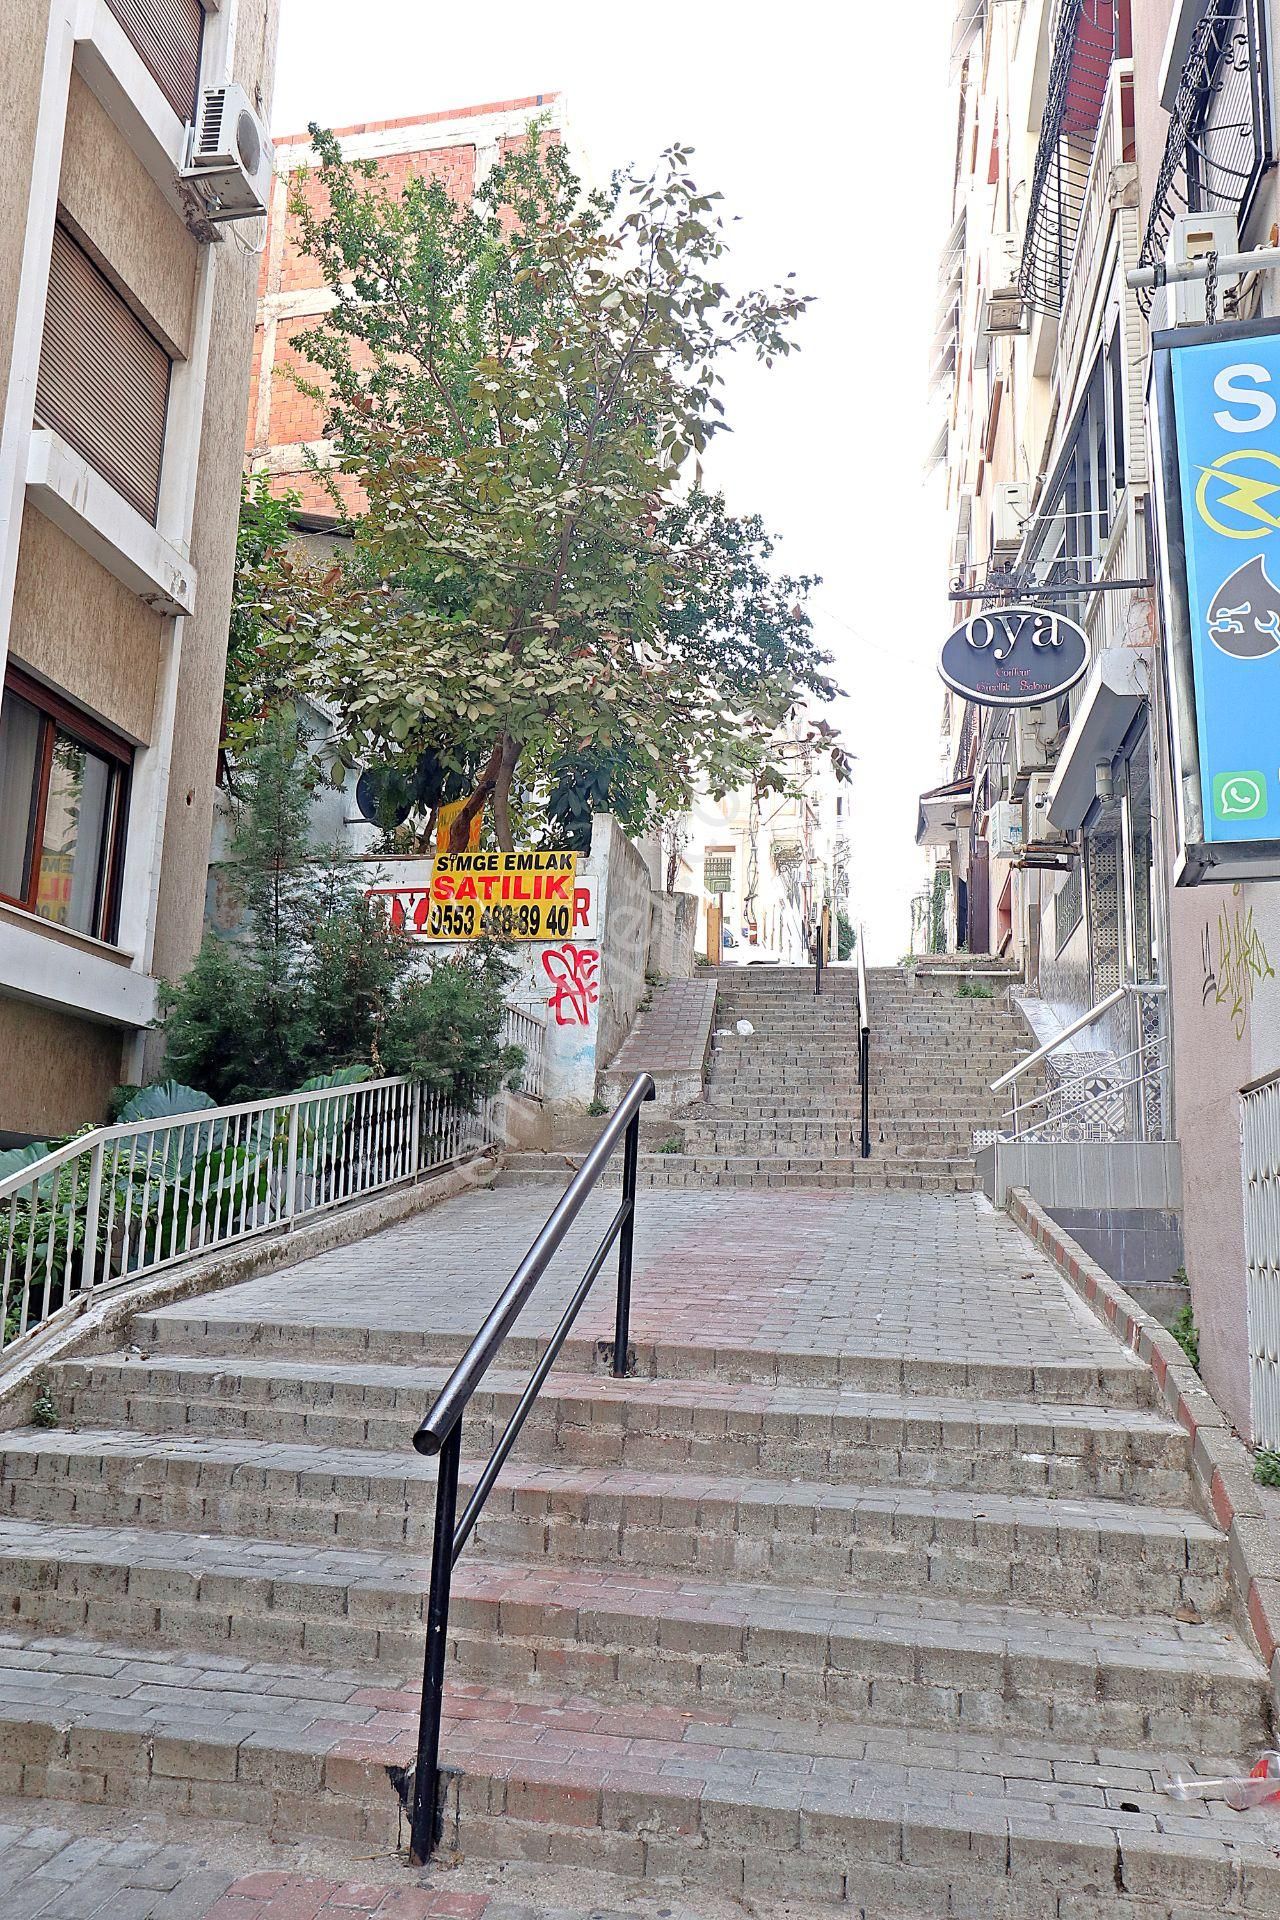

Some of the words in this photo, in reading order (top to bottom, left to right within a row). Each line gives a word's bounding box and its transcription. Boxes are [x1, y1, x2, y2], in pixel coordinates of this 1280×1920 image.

[964, 613, 1064, 660] oya
[504, 853, 573, 870] EMLAK
[432, 875, 570, 900] SATILIK
[431, 904, 474, 936] 0553
[546, 904, 569, 936] 40
